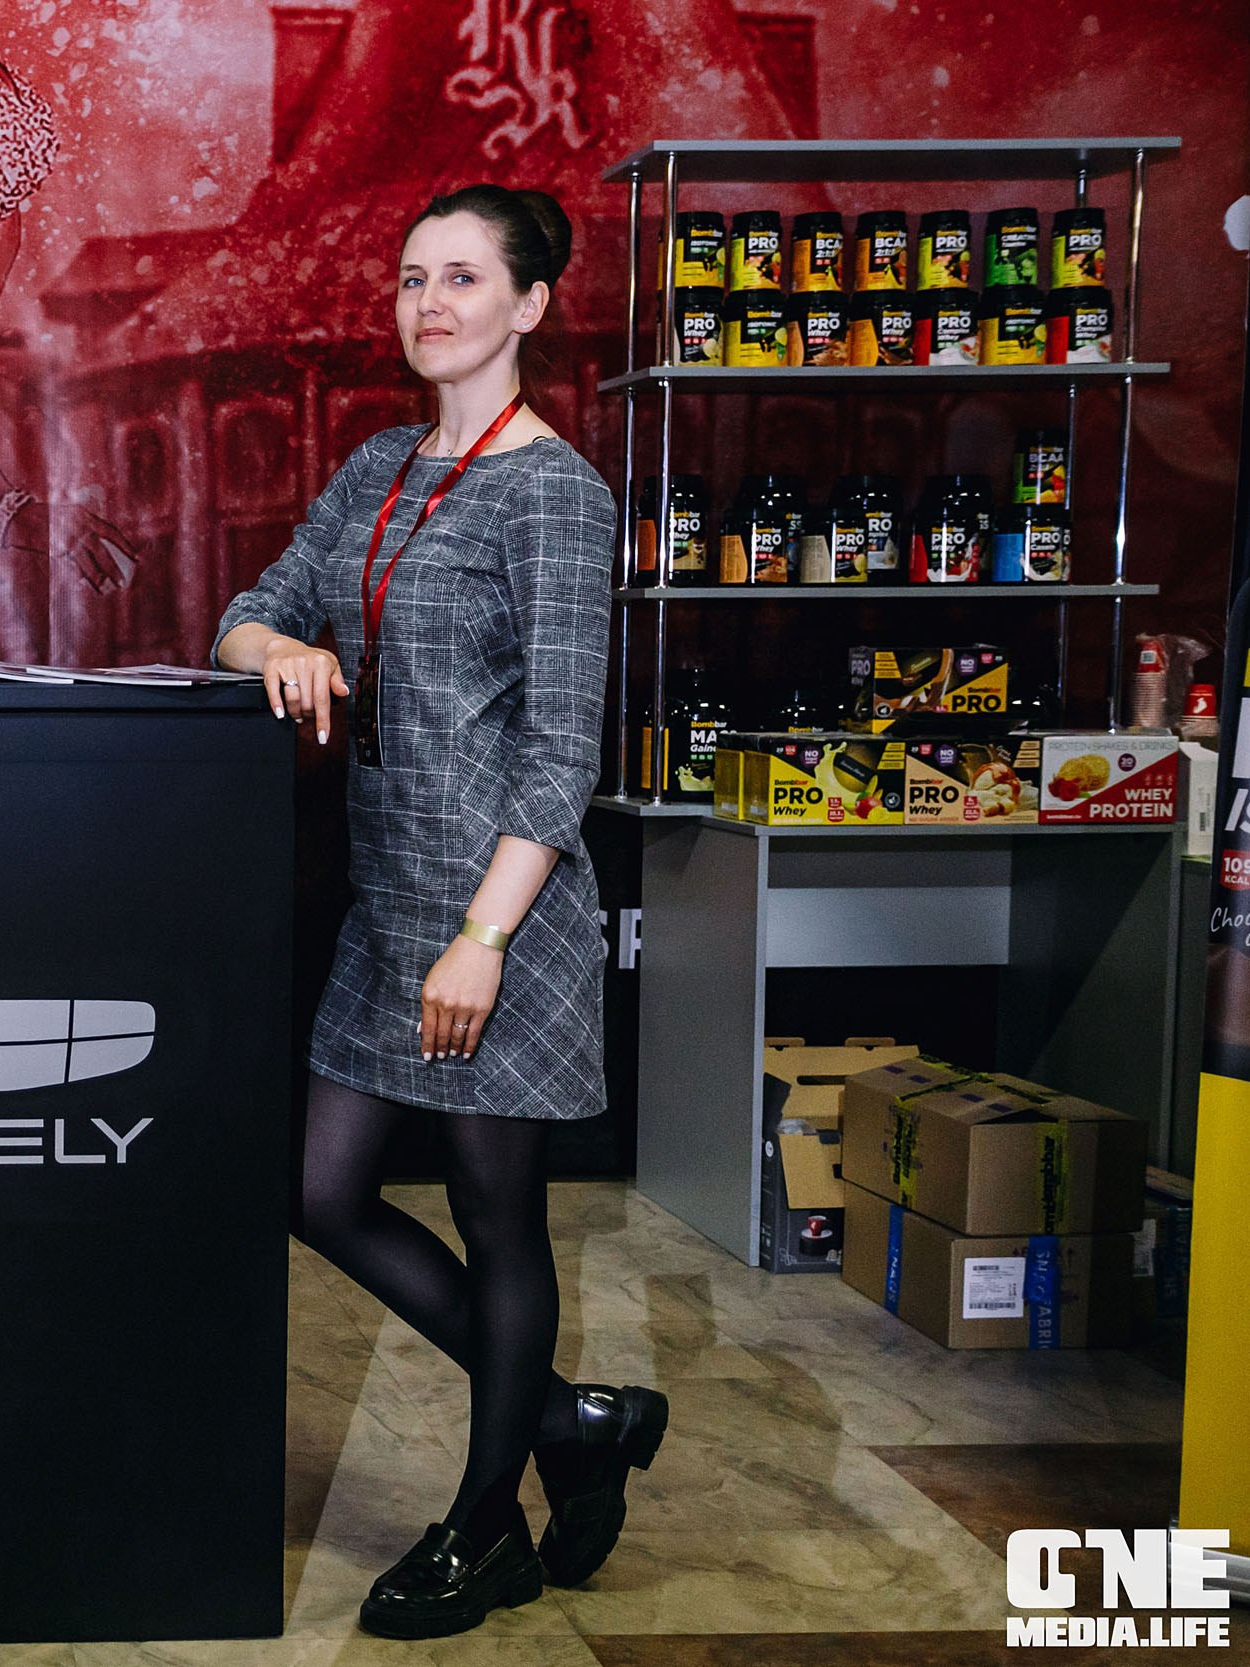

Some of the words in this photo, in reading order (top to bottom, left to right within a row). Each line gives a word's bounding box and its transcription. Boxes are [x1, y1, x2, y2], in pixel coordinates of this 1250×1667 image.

[748, 238, 778, 249] PRO
[935, 236, 967, 248] PRO
[1069, 234, 1102, 246] PRO
[684, 318, 715, 330] PRO
[808, 318, 840, 329] PRO
[882, 318, 912, 329] PRO
[938, 317, 971, 328] PRO
[1075, 315, 1108, 326] PRO
[868, 519, 892, 531] RO
[753, 533, 782, 545] PRO
[836, 534, 864, 545] PRO
[932, 533, 965, 544] PRO
[1031, 532, 1061, 543] PRO
[851, 660, 870, 675] PRO
[952, 694, 1002, 712] PRO
[774, 787, 823, 805] PRO
[909, 786, 959, 804] PRO
[1124, 788, 1172, 800] WHEY
[773, 806, 807, 816] Whey
[909, 806, 942, 816] Whey
[1090, 803, 1173, 818] PROTEIN
[1224, 875, 1250, 885] KCAL
